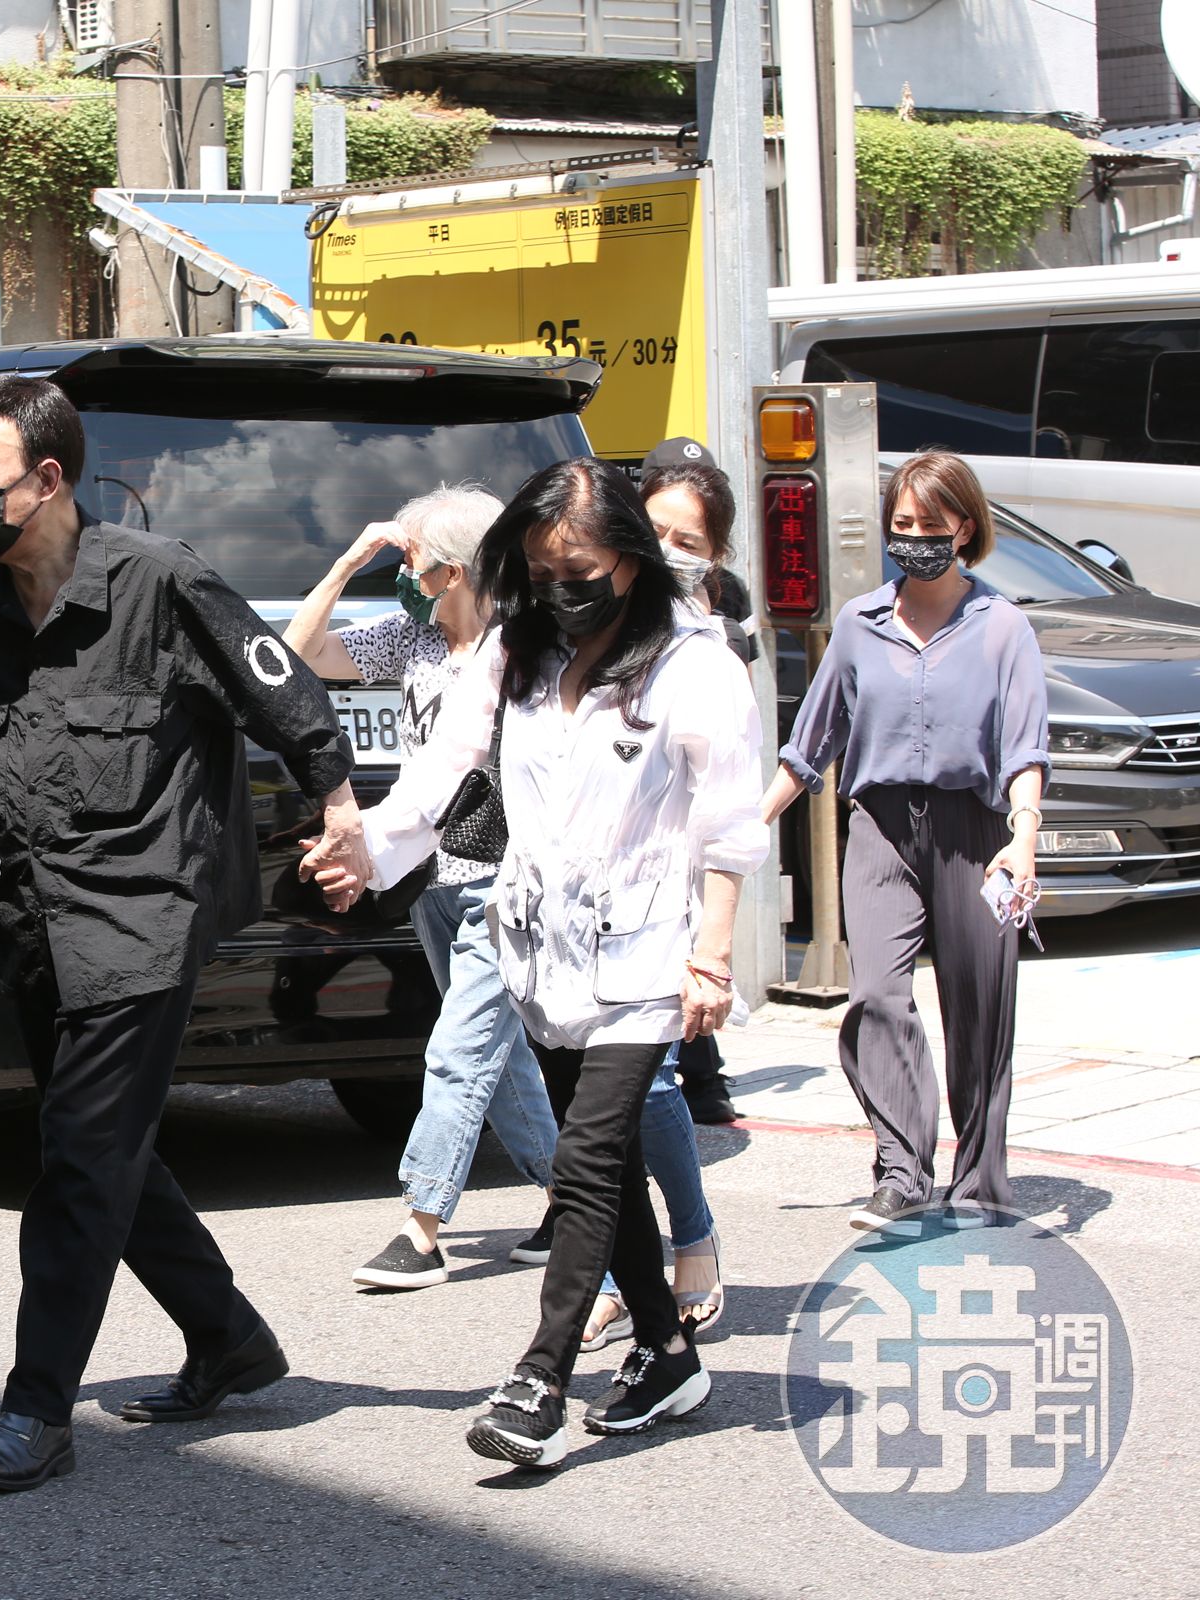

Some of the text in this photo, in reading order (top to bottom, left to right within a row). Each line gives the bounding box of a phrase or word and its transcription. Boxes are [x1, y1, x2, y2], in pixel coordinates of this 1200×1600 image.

[555, 202, 653, 230] 例假日及國定假日
[327, 233, 357, 248] Times
[428, 224, 449, 243] 平日
[780, 487, 808, 604] 出車注意
